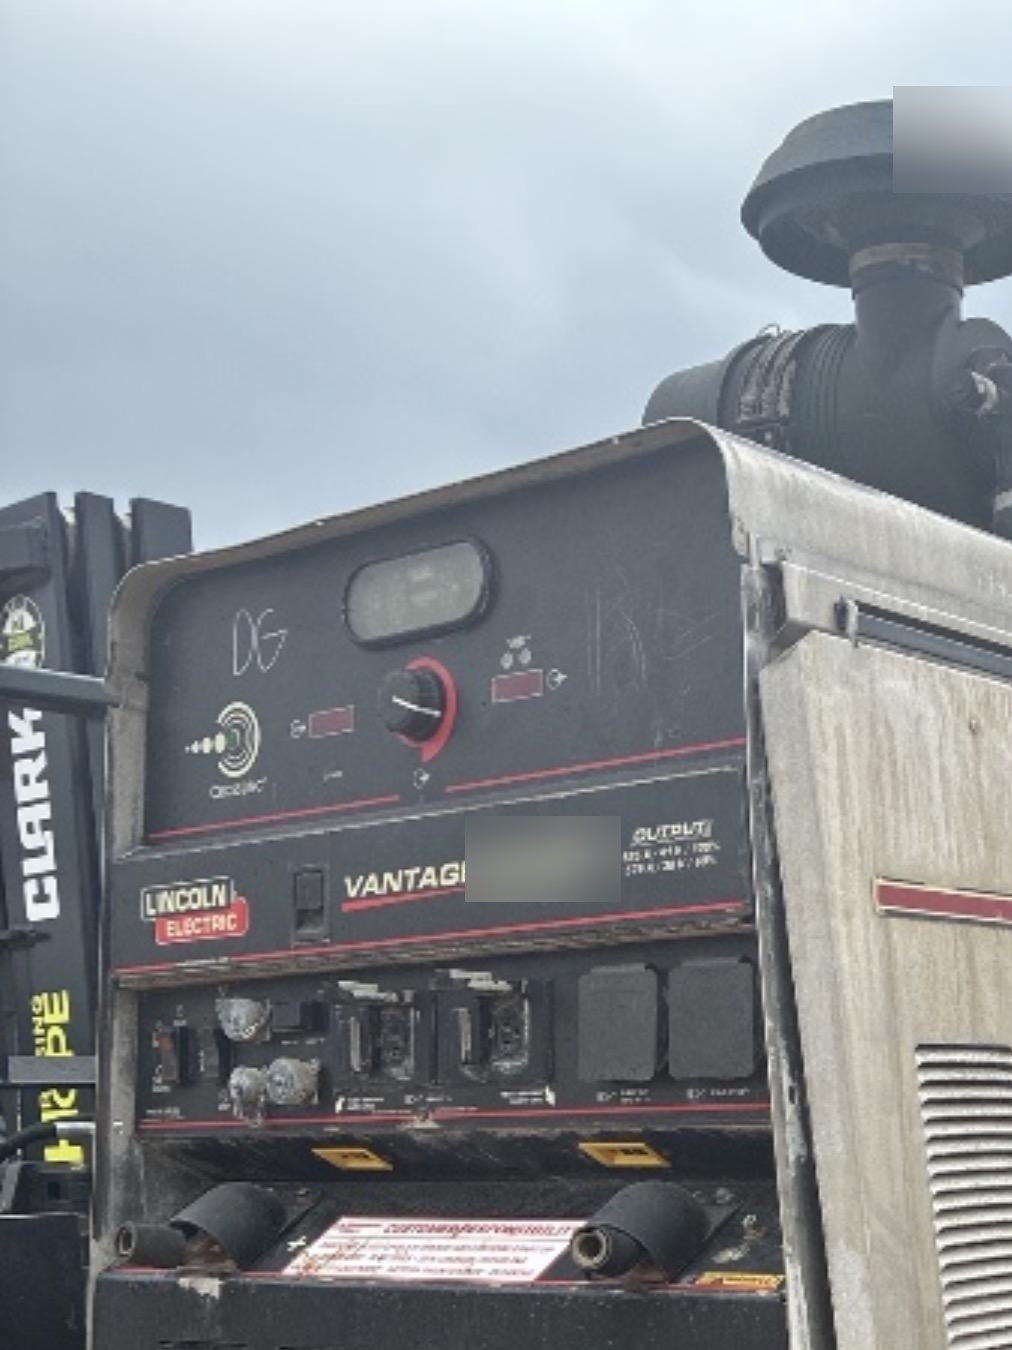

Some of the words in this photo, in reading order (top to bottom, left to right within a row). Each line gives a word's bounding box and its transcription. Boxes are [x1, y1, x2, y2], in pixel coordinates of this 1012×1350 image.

[7, 706, 60, 922] CLARK
[344, 861, 465, 898] VANTAG
[145, 884, 227, 916] LINCOLN
[166, 914, 239, 938] ELECTRIC
